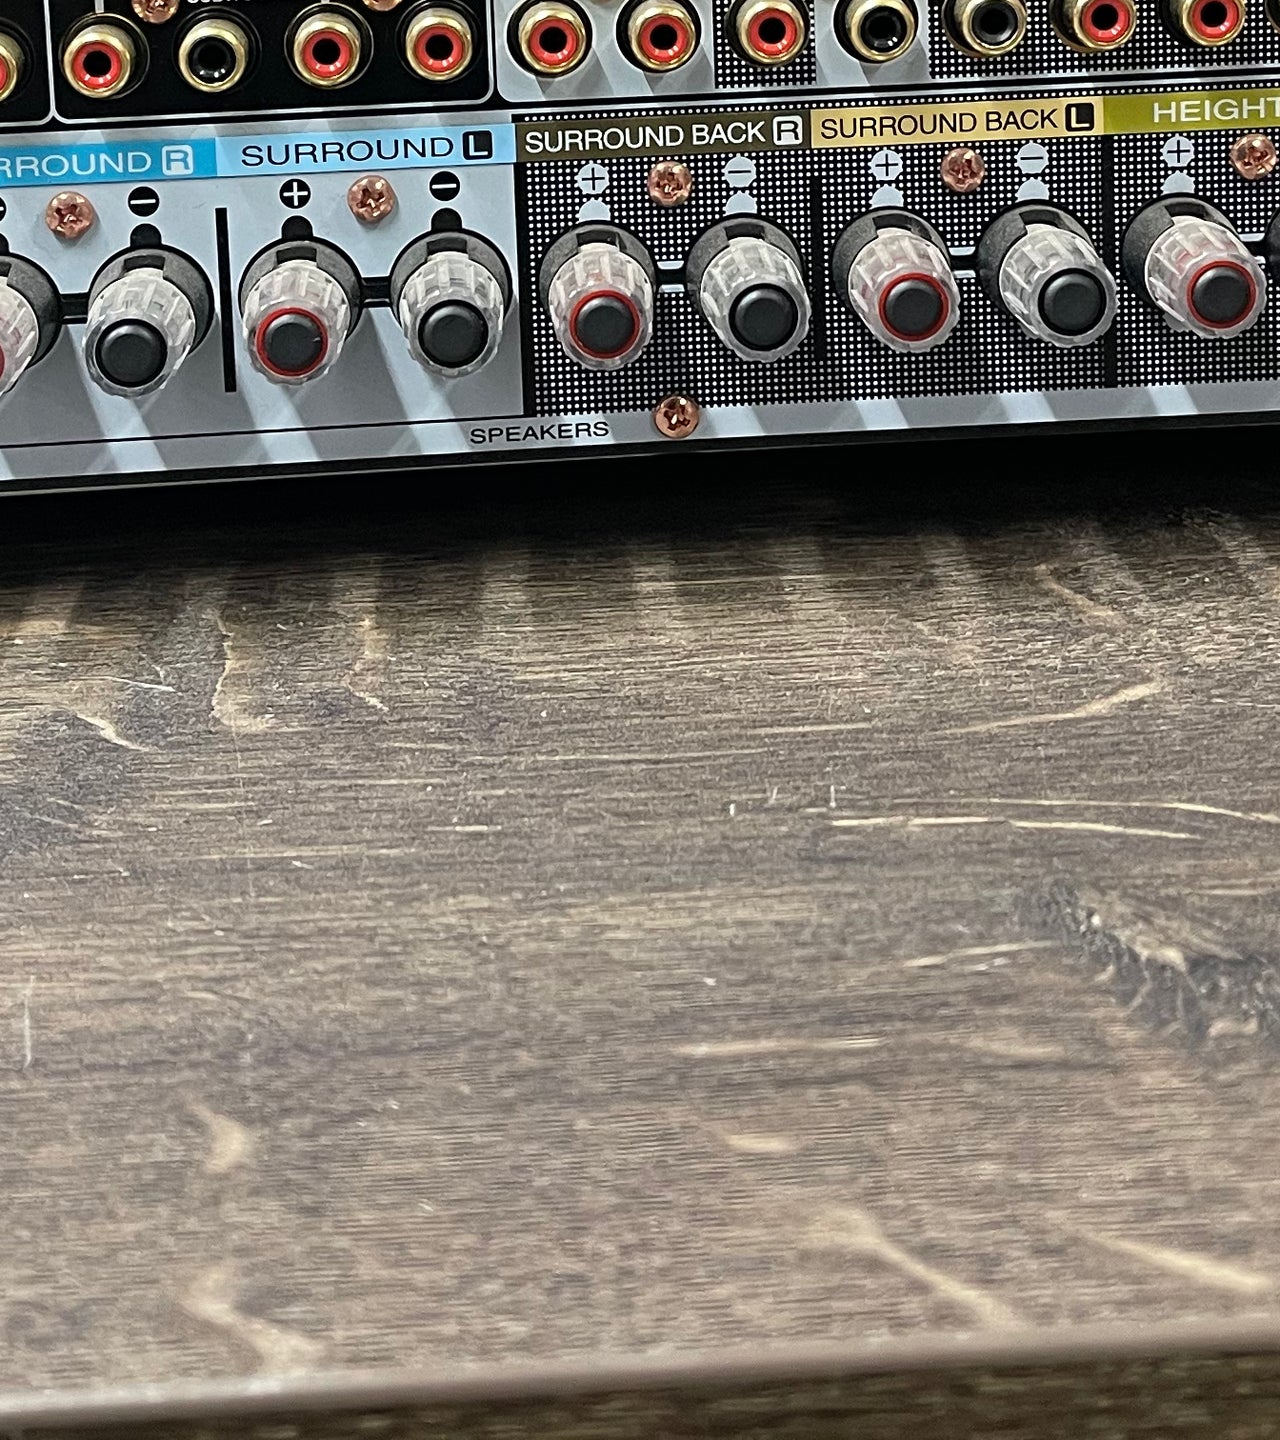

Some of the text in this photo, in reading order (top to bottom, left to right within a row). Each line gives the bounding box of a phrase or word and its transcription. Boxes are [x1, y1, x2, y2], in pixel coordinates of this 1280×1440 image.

[525, 122, 765, 153] SURROUND BACK
[821, 108, 1058, 139] SURROUND BACK
[241, 137, 454, 168] SURROUND
[470, 422, 609, 445] SPEAKERS
